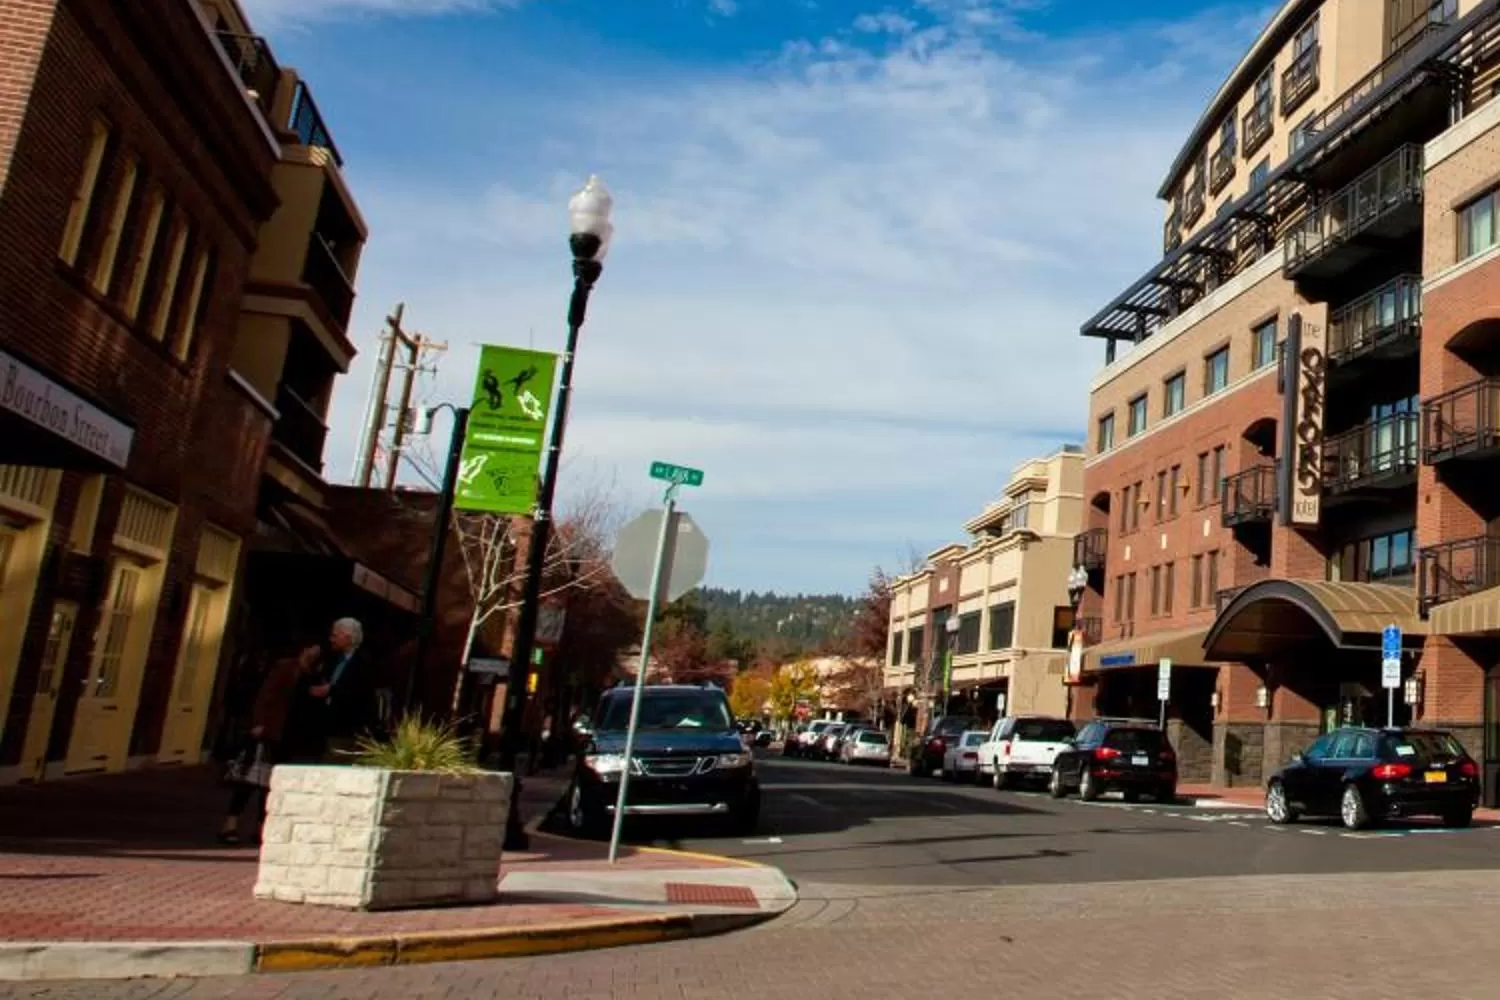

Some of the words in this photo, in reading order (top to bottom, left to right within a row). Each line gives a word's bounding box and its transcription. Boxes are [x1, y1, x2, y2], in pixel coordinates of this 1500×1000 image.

[2, 364, 69, 433] Bourbon
[69, 403, 110, 455] Street
[1298, 347, 1324, 496] OXFORD
